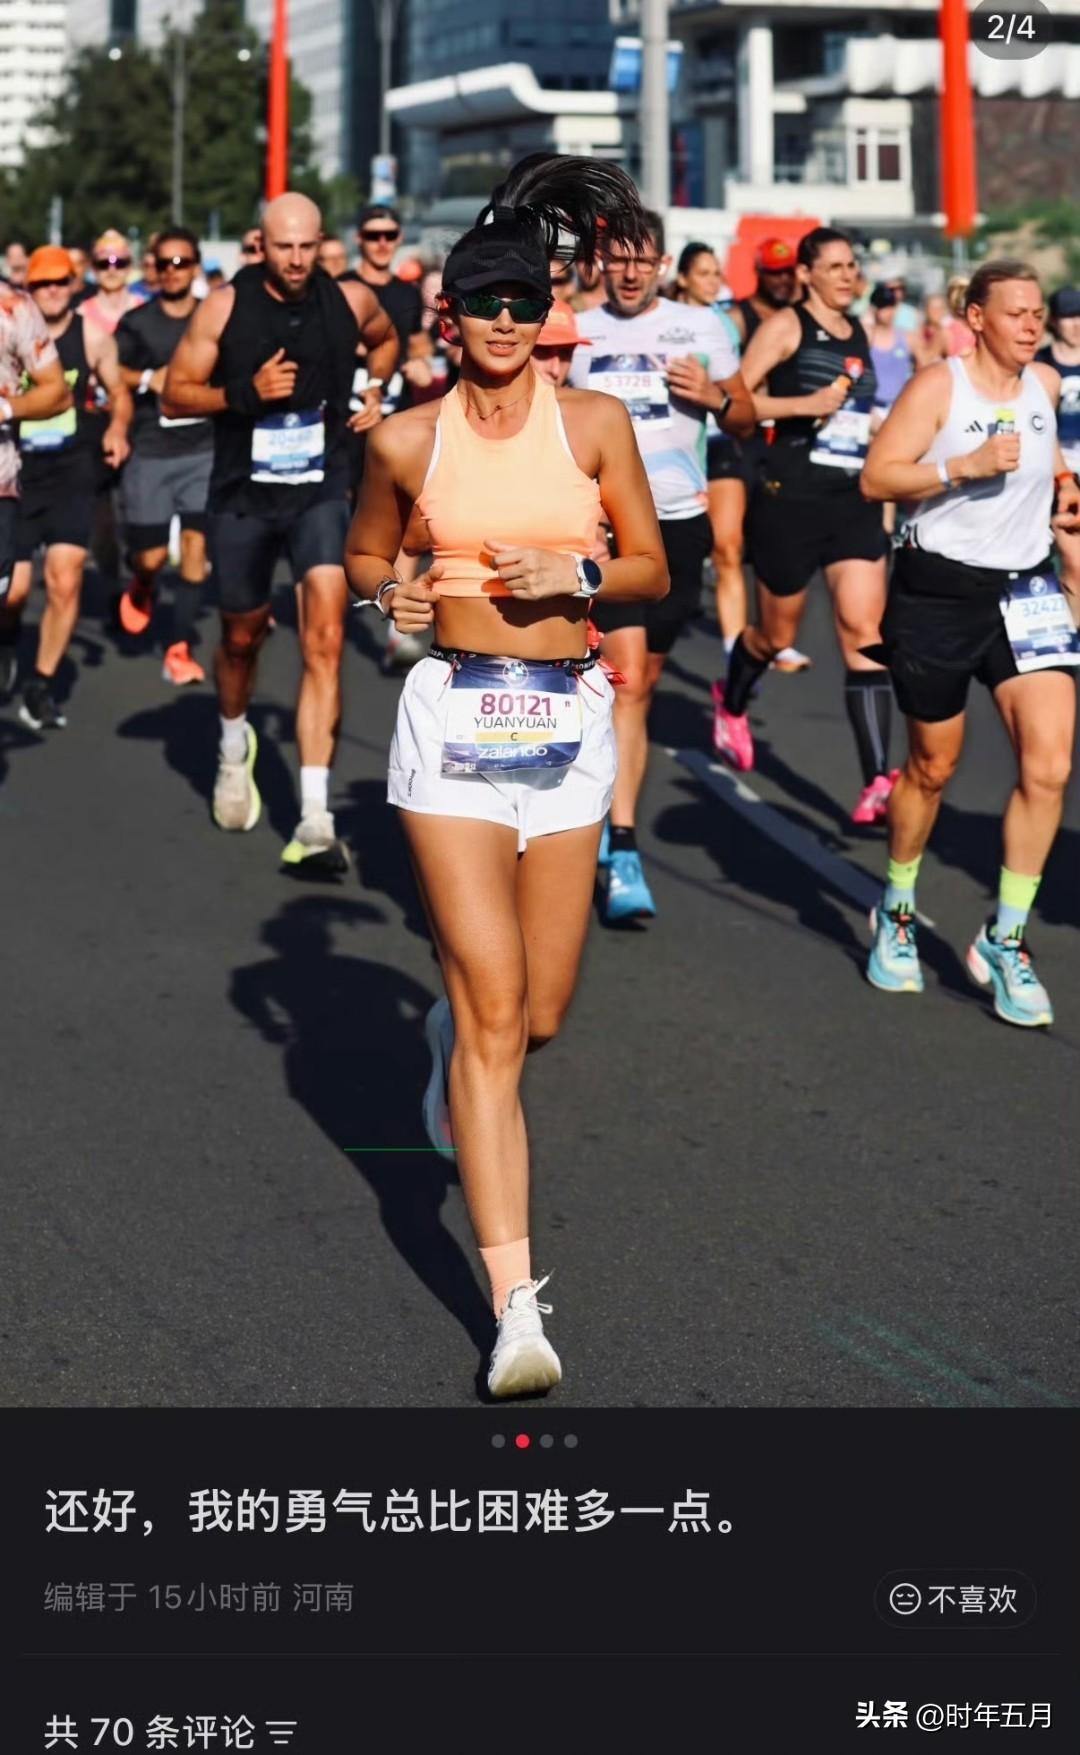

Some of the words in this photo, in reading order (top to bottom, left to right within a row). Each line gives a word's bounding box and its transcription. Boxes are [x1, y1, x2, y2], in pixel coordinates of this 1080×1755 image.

[480, 693, 552, 716] 80121
[473, 717, 557, 729] YUANYUAN
[510, 732, 519, 742] C
[477, 745, 548, 760] zalando
